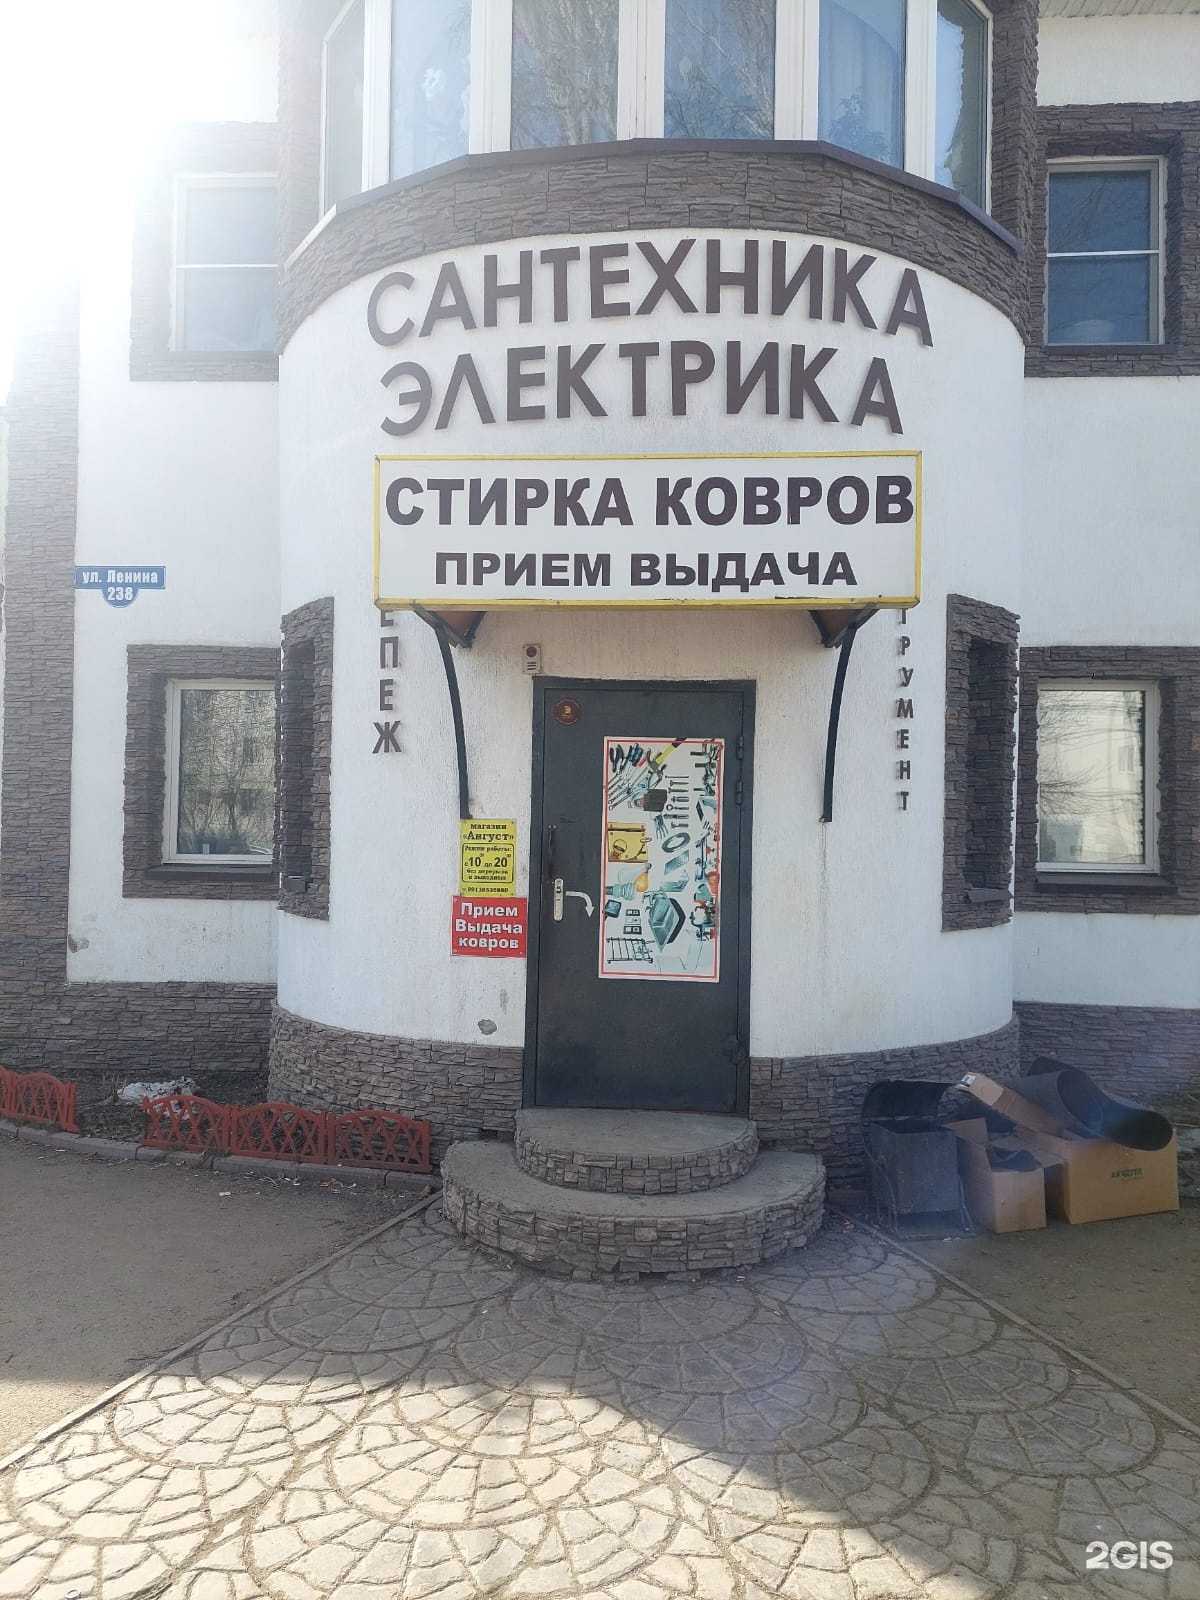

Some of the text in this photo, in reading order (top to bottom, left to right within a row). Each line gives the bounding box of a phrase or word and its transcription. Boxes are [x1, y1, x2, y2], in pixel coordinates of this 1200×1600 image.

[366, 238, 933, 347] САНТЕХНИКА
[380, 340, 904, 437] ЭЛЕКТРИКА
[385, 475, 915, 526] СТИРКА КОВРОВ
[82, 569, 158, 584] ул. Ленина
[435, 551, 858, 592] ПРИЕМ ВЫДАЧА
[461, 902, 518, 918] Прием
[455, 918, 523, 935] Выдача
[458, 937, 519, 951] ковров
